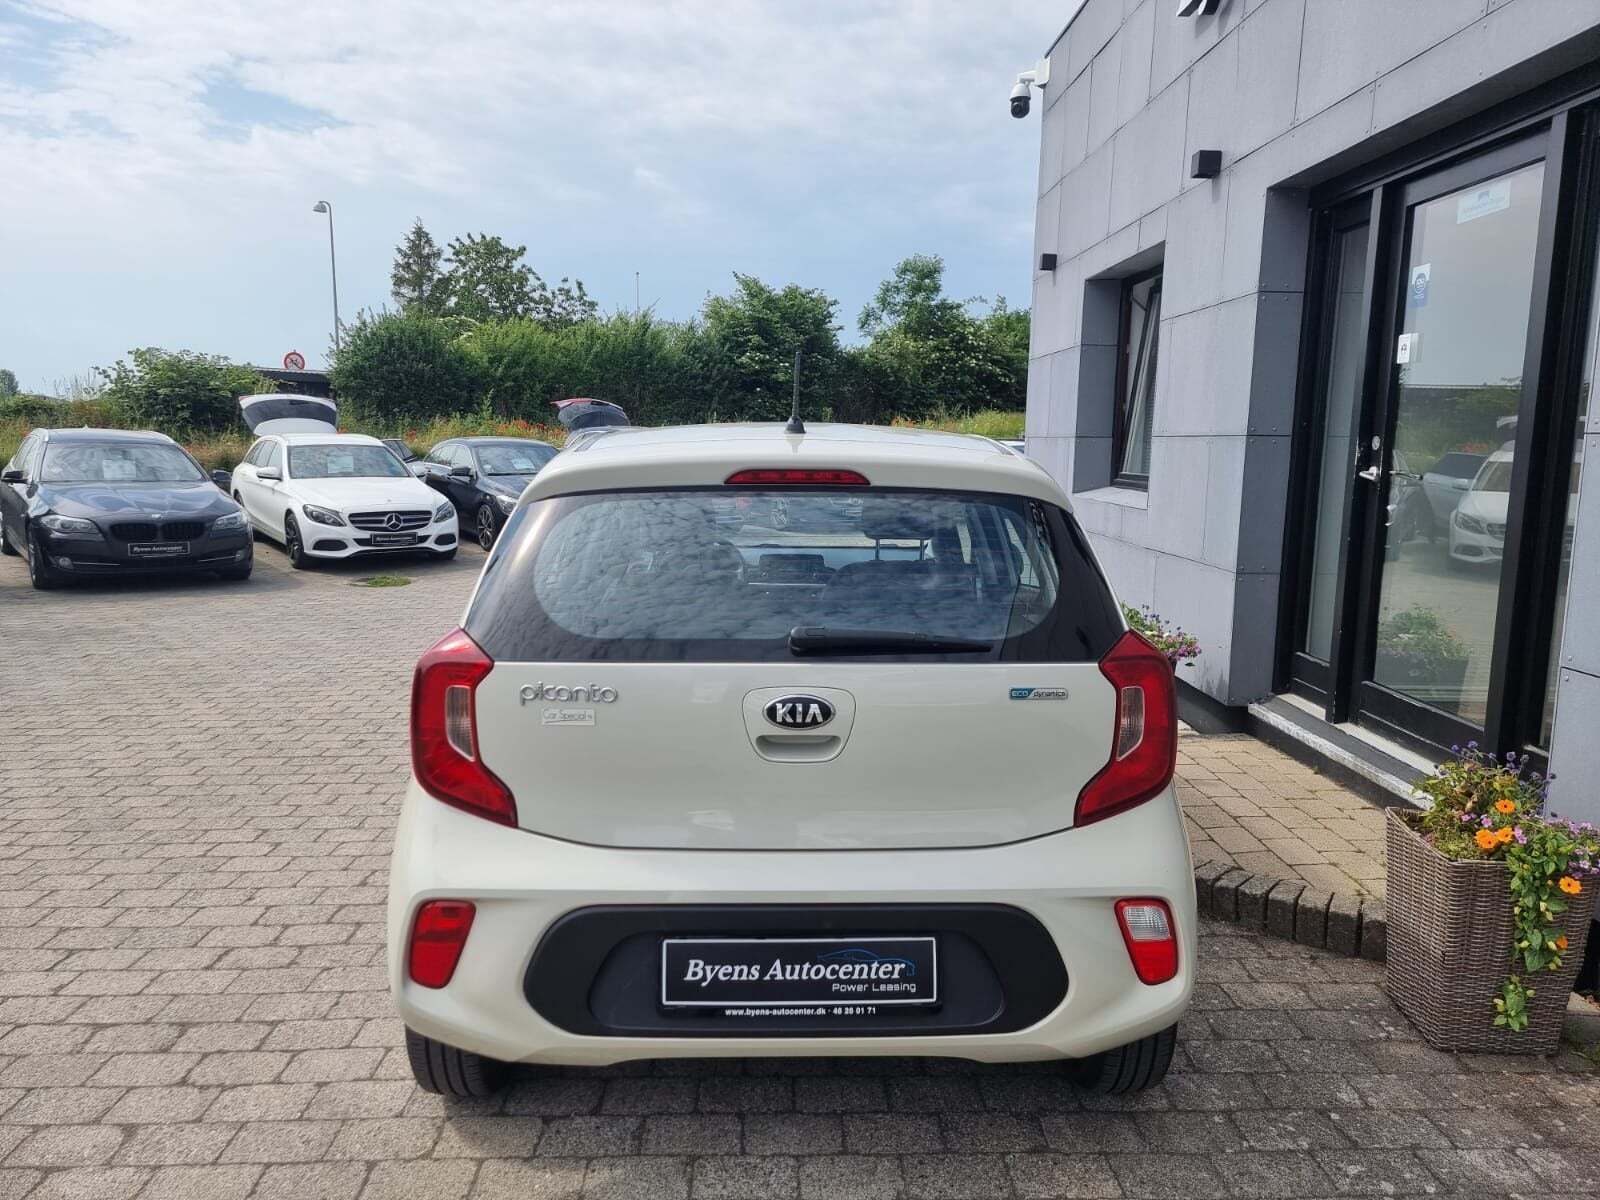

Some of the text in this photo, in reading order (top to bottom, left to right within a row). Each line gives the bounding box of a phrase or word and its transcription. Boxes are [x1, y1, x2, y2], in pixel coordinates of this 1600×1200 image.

[520, 681, 618, 705] picanto
[776, 703, 823, 723] KIA
[683, 958, 906, 987] Byens Autocenter
[832, 983, 916, 993] Power Leasing
[725, 1007, 826, 1017] www.byens-autocenter.dk
[867, 1005, 876, 1014] 71
